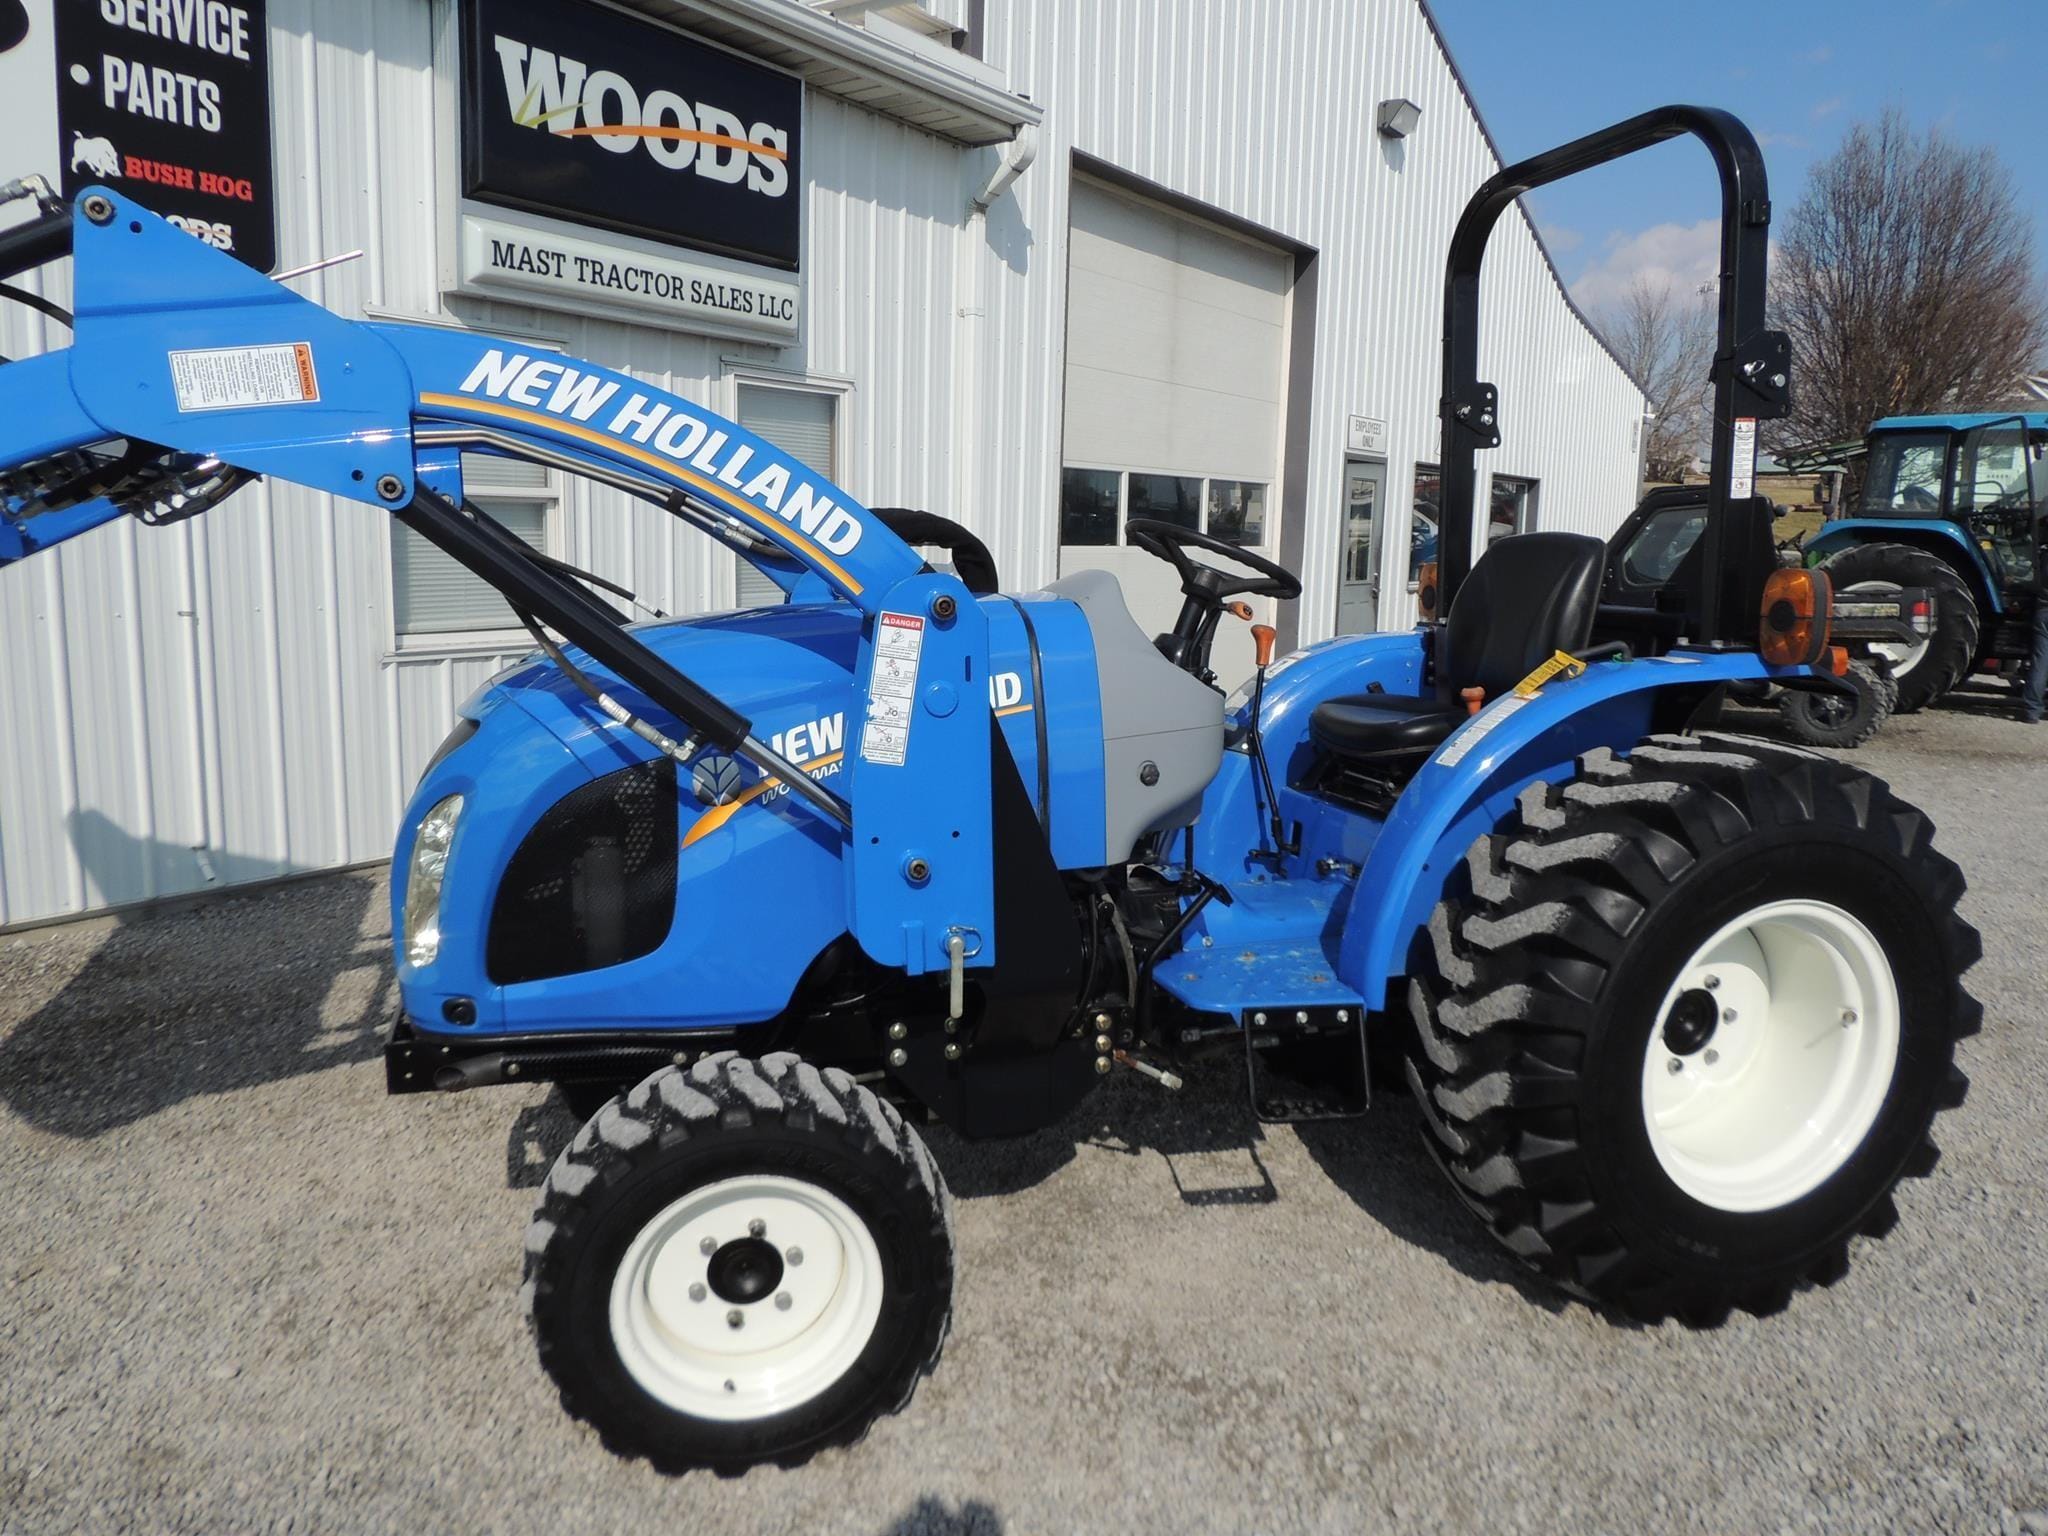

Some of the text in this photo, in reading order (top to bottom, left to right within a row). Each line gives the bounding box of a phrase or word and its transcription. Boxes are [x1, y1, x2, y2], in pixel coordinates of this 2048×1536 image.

[103, 53, 222, 133] PARTS
[494, 34, 789, 198] WOODS
[124, 155, 254, 201] BUSH HOG
[492, 240, 793, 321] MAST TRACTOR SALES LLC
[300, 359, 313, 396] WARNING
[1355, 419, 1382, 435] EMPLOYEES
[1362, 435, 1374, 448] ONLY
[458, 349, 862, 556] NEW HOLLAND
[890, 617, 921, 628] DANGER
